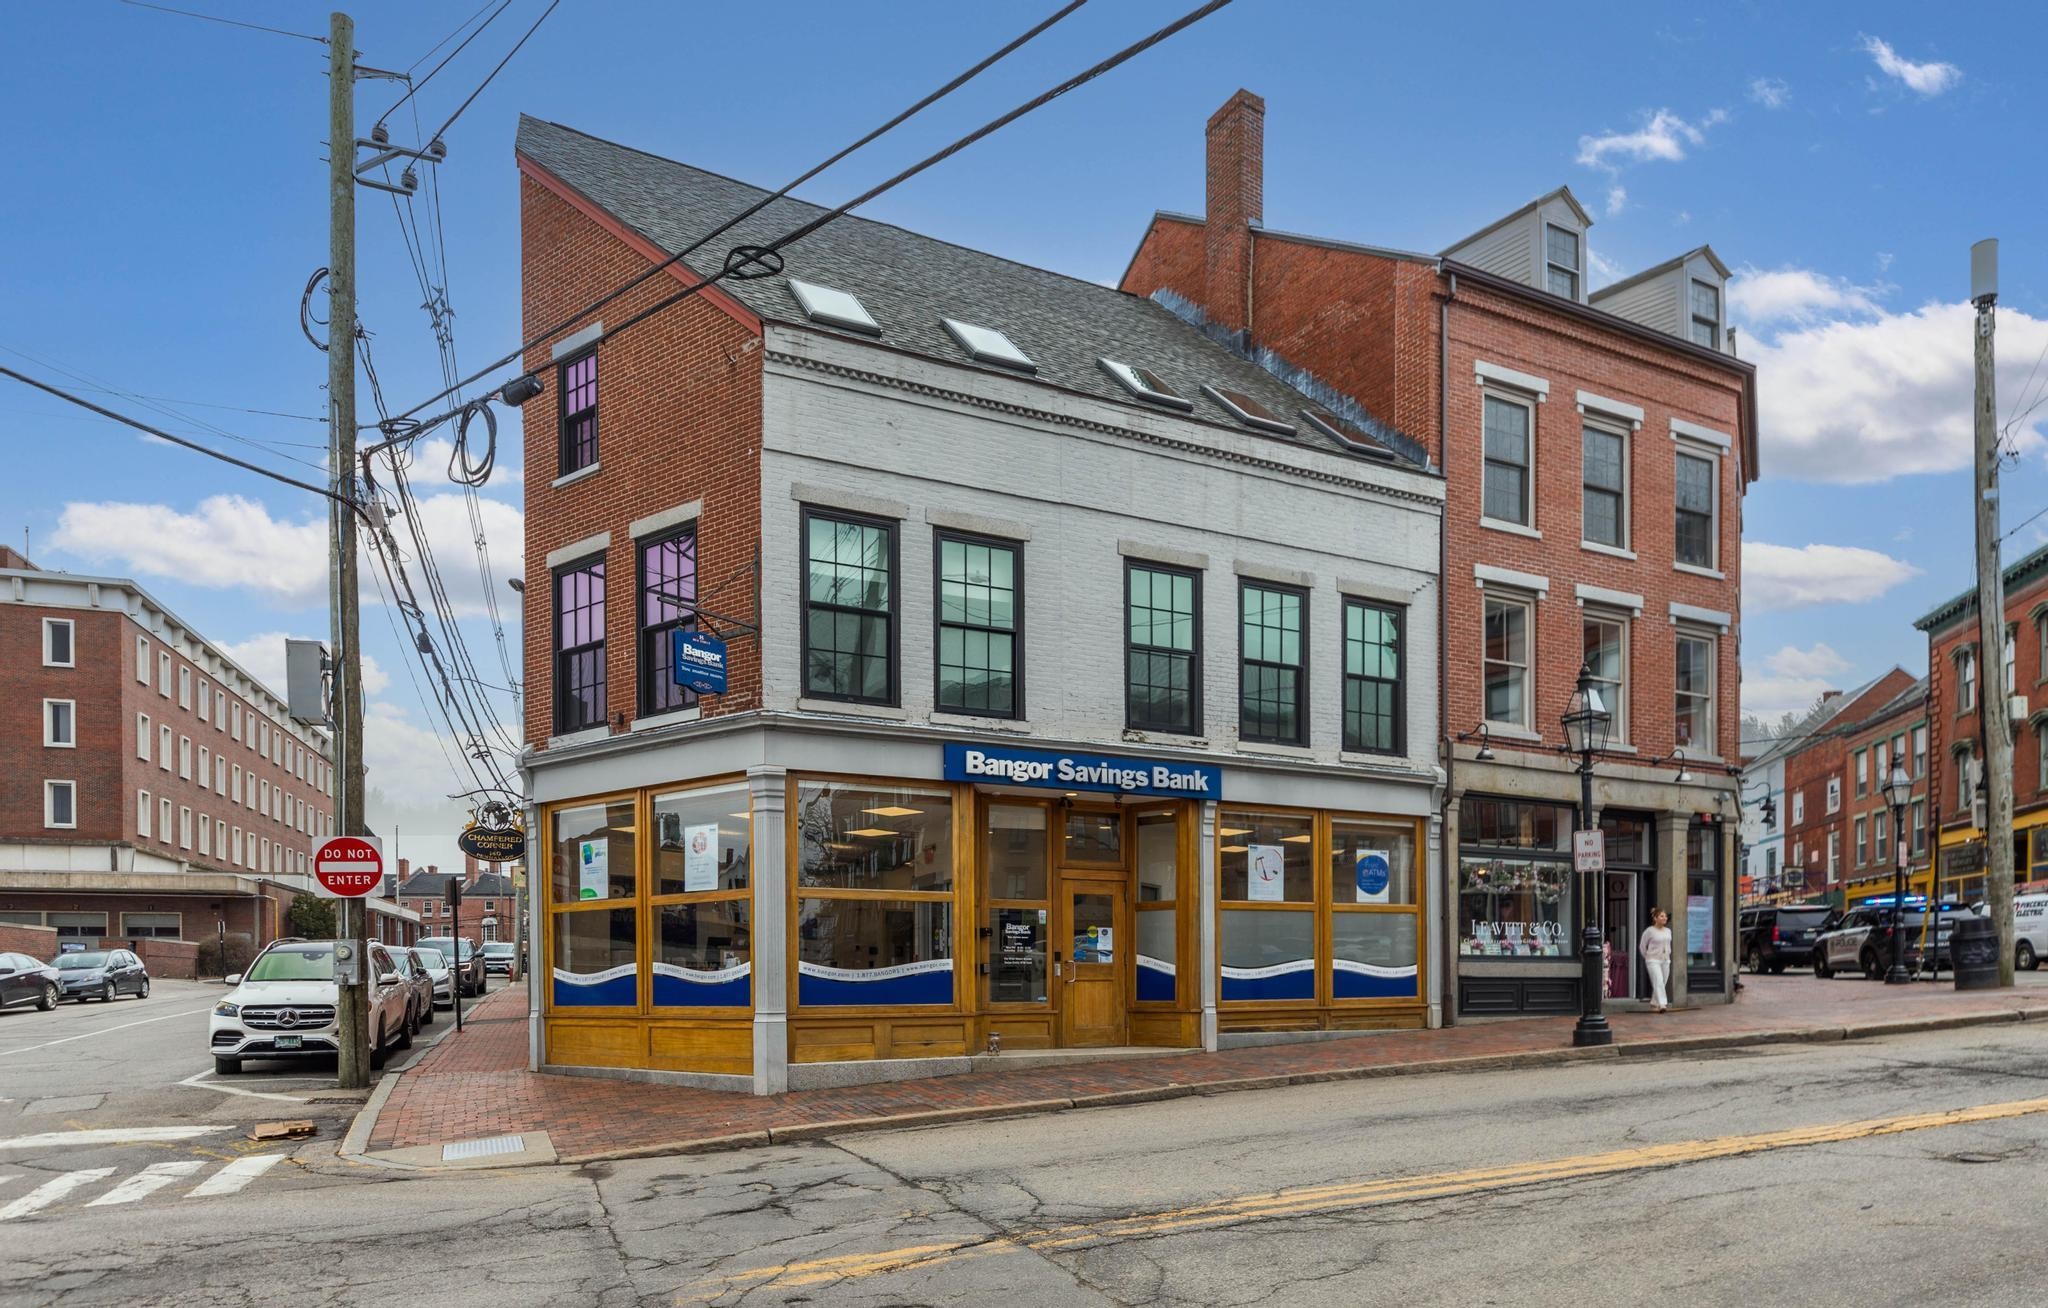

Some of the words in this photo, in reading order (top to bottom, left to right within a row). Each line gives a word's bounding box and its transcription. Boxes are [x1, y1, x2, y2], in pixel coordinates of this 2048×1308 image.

[683, 643, 722, 662] Bangor
[682, 653, 707, 665] Savings
[707, 660, 724, 669] Bank
[966, 750, 1053, 782] Bangor
[1057, 758, 1149, 790] Savings
[1152, 766, 1209, 792] Bank
[468, 834, 523, 843] CHAMFERED
[477, 842, 513, 850] CORNER
[324, 849, 341, 859] DO
[347, 849, 372, 859] NOT
[328, 875, 371, 885] ENTER
[2016, 908, 2044, 917] ELECTRIC
[1006, 923, 1030, 932] Bangor
[1471, 919, 1527, 936] LEAVITT
[1529, 921, 1540, 936] &
[803, 965, 850, 978] www.bangor.com
[906, 961, 950, 972] www.bangor.com
